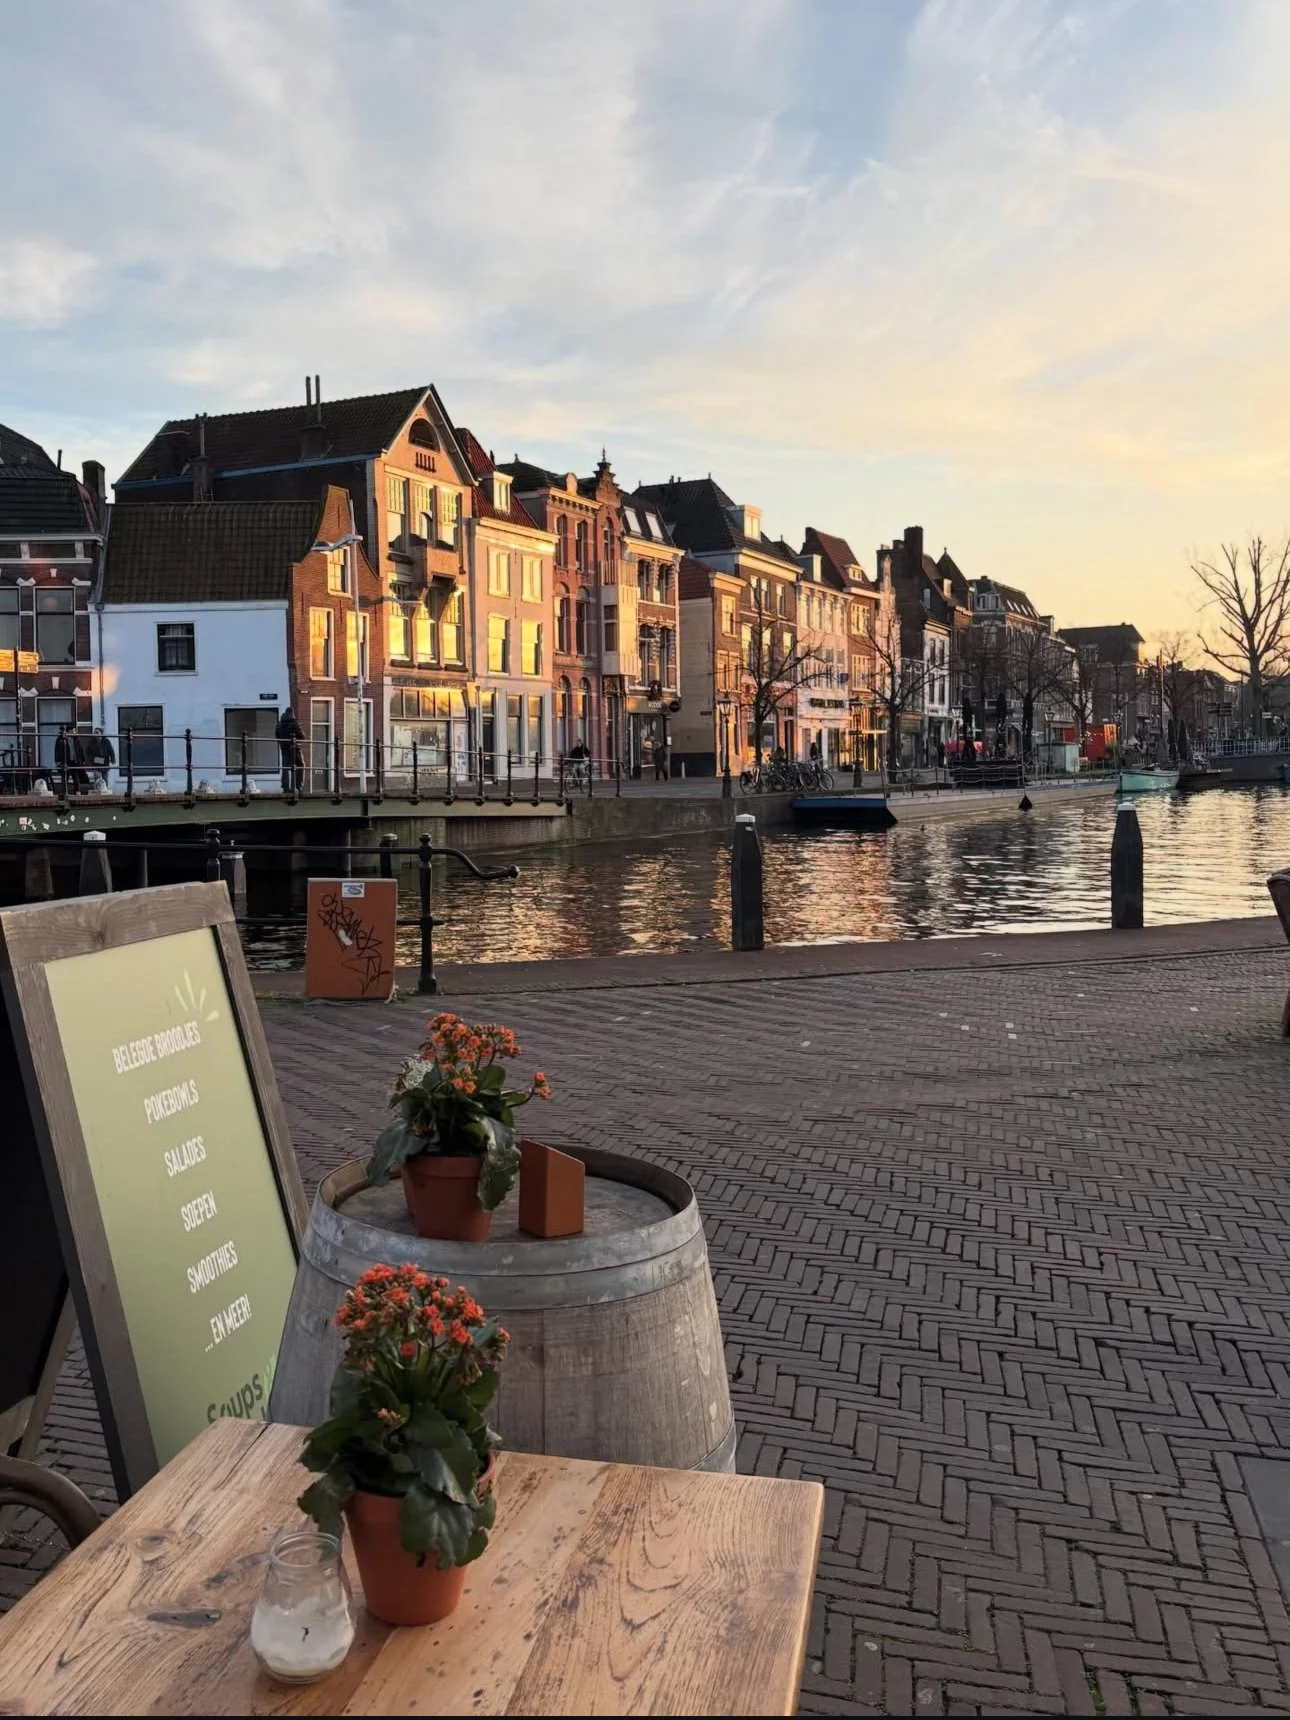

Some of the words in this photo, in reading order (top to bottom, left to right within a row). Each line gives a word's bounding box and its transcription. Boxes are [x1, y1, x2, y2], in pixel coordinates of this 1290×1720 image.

[112, 1036, 157, 1074] BELEGDE
[153, 1020, 201, 1058] BROODJES
[144, 1079, 199, 1124] POKEBOWLS
[164, 1136, 207, 1178] SALADES
[181, 1190, 217, 1232] SOEPEN
[187, 1240, 238, 1293] SMOOTHIES
[222, 1293, 252, 1335] MEER!
